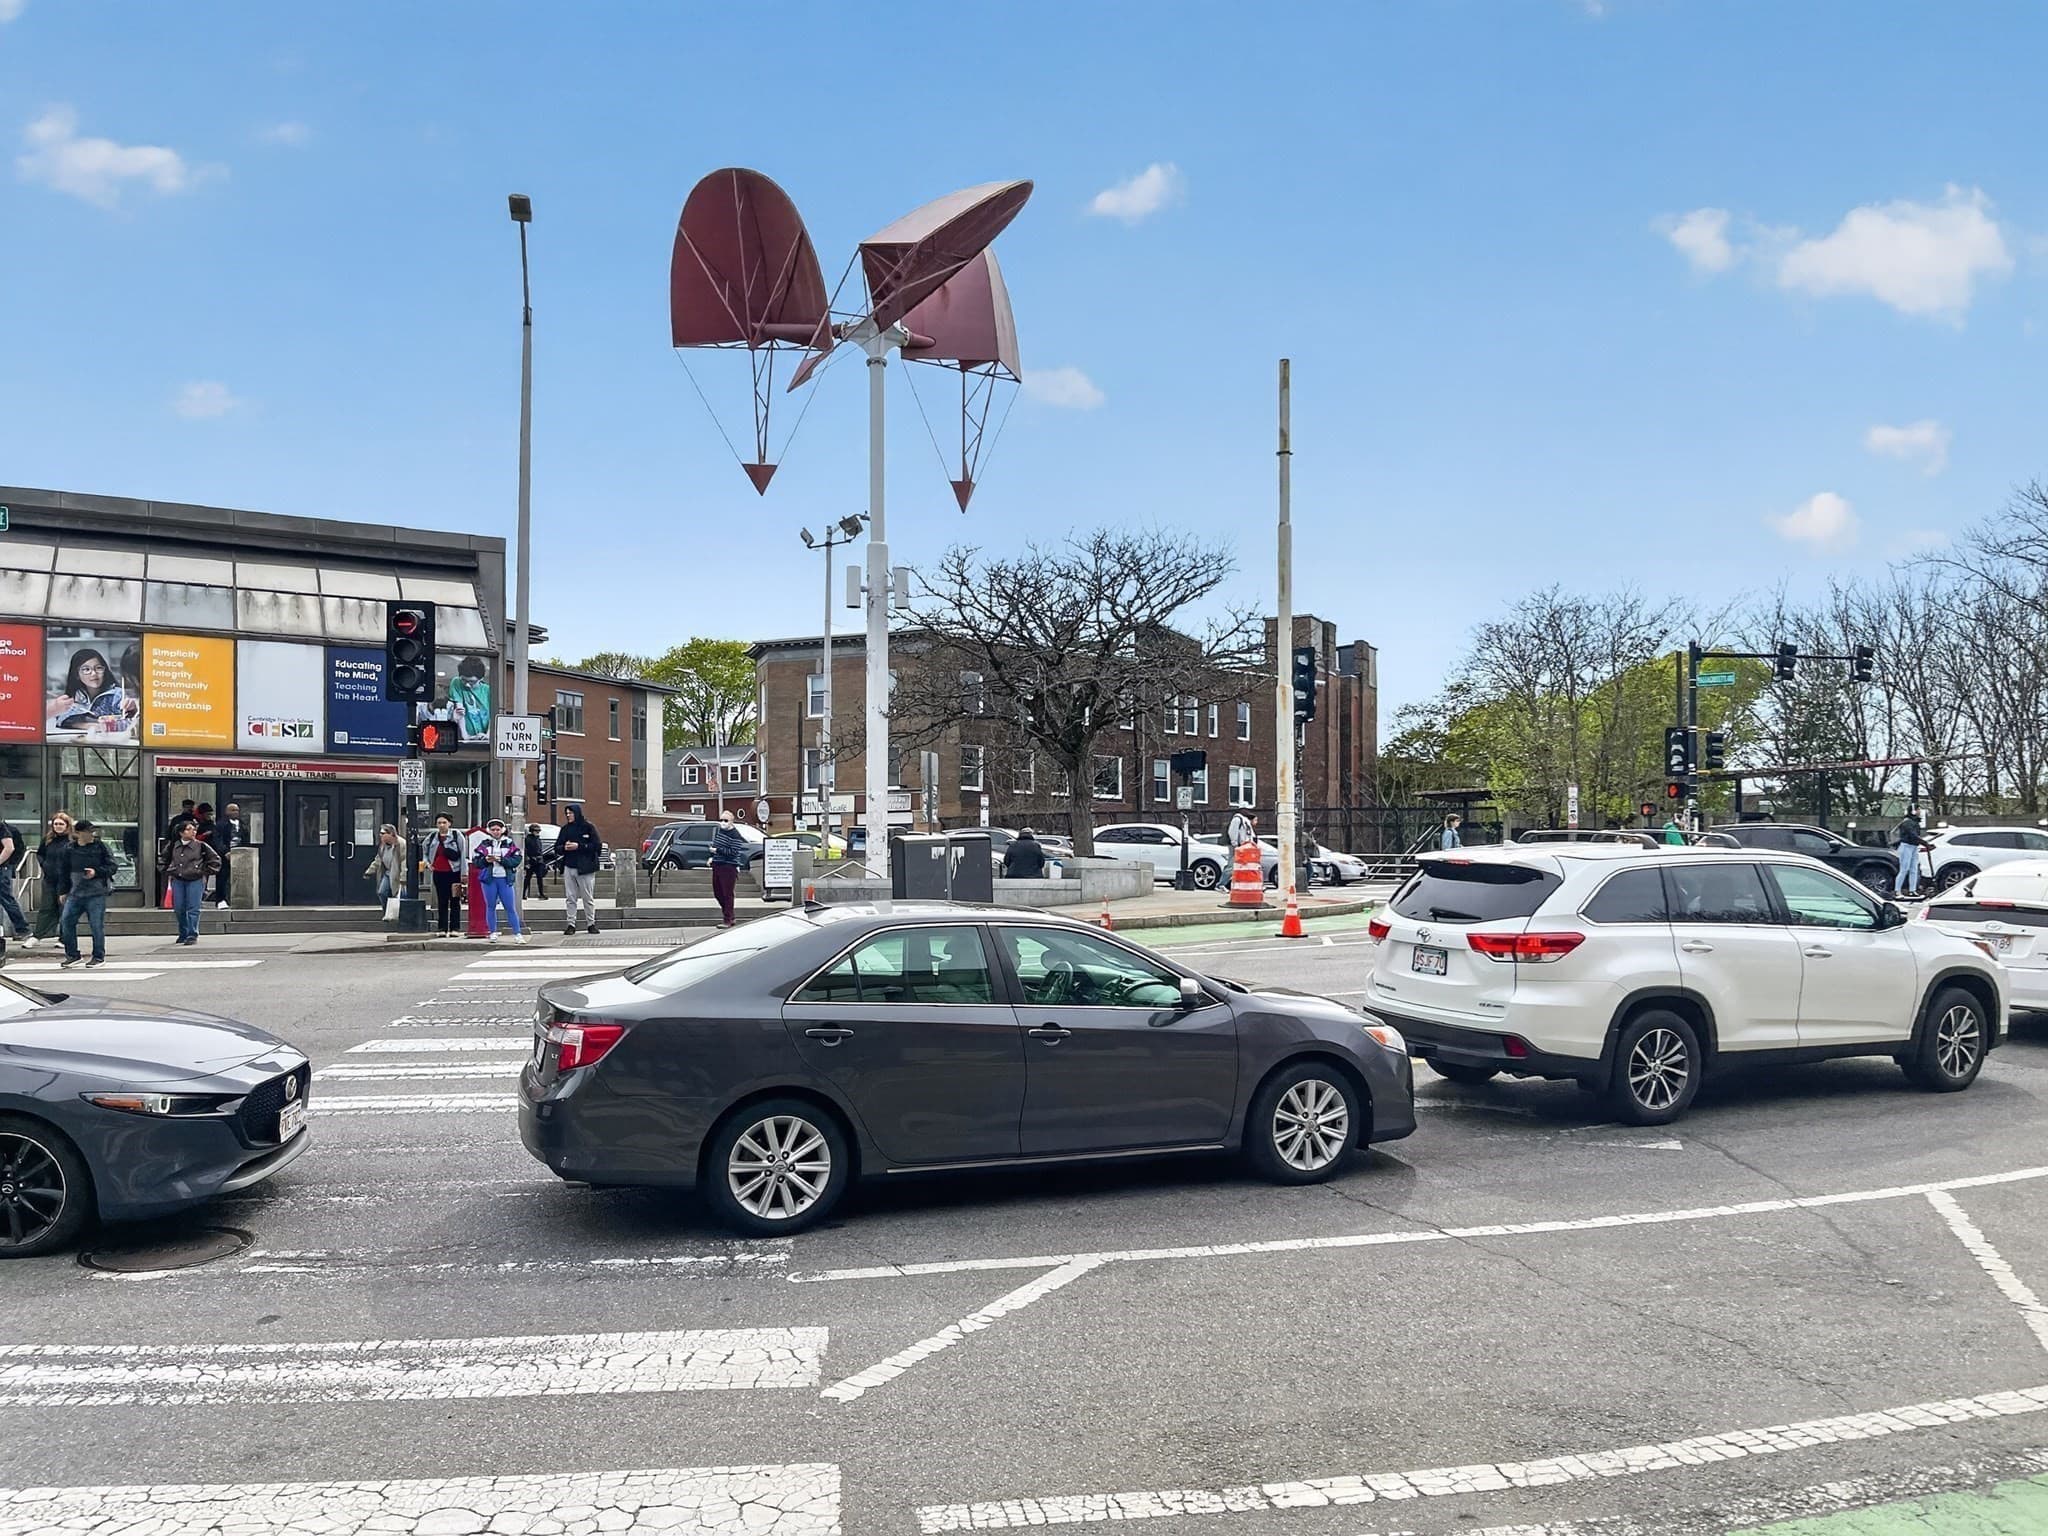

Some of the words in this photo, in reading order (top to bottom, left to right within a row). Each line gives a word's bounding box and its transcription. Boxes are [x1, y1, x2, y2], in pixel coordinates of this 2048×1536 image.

[152, 648, 199, 659] Simplicity
[152, 659, 184, 668] Peace
[335, 660, 382, 673] Educating
[152, 670, 192, 680] Integrity
[335, 670, 350, 679] the
[352, 671, 378, 682] Mind,
[152, 680, 208, 691] Community
[335, 682, 377, 693] Teaching
[152, 690, 190, 701] Equality
[335, 692, 350, 700] the
[352, 693, 380, 702] Heart.
[152, 701, 212, 712] Stewardship
[512, 722, 526, 731] NO
[505, 732, 532, 741] TURN
[499, 742, 513, 751] ON
[518, 743, 538, 752] RED
[261, 762, 298, 770] PORTER
[220, 768, 269, 777] ENTRANCE
[305, 772, 337, 780] TRAINS
[437, 786, 481, 795] ELEVATOR
